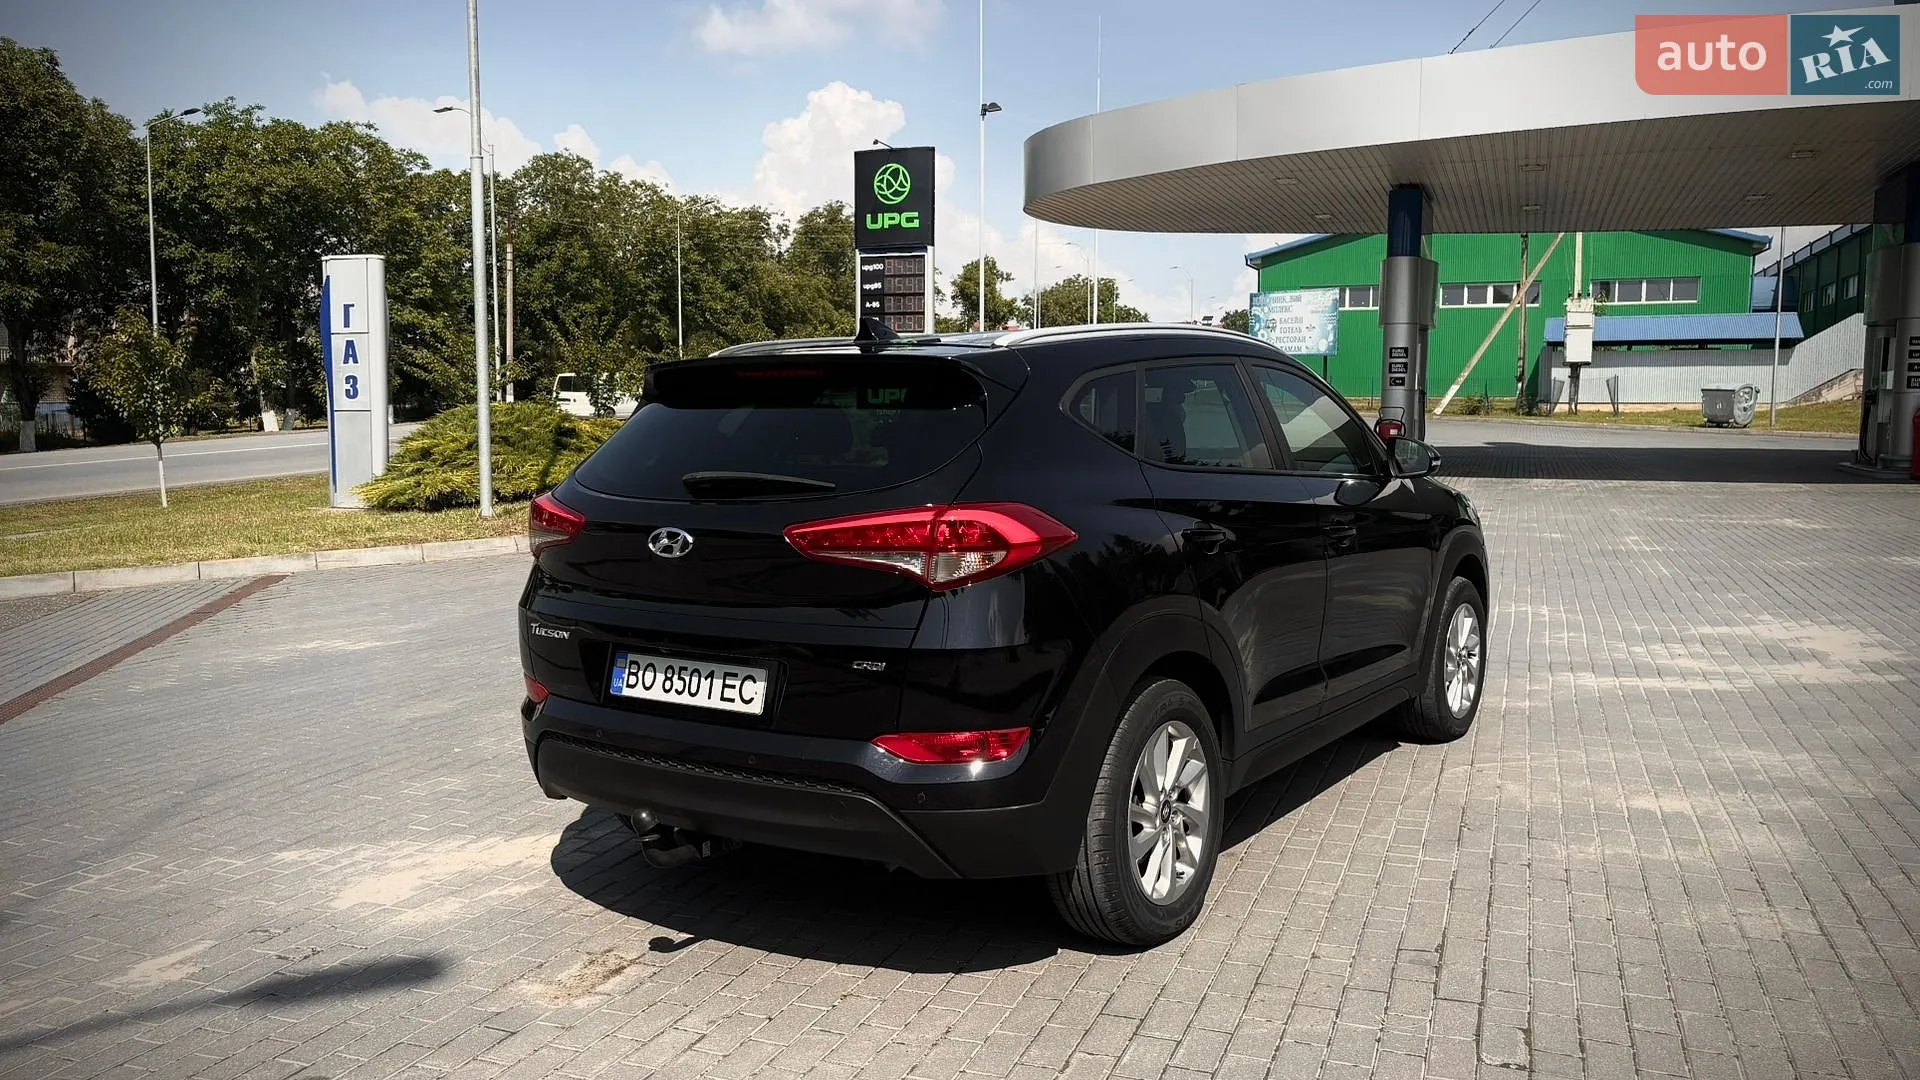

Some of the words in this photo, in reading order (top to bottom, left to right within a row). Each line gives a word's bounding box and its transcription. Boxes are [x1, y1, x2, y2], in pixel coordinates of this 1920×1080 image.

[866, 211, 920, 230] UPG
[342, 303, 360, 400] ГАЗ
[625, 659, 657, 691] BO
[662, 664, 715, 700] 8501
[720, 671, 757, 705] EC
